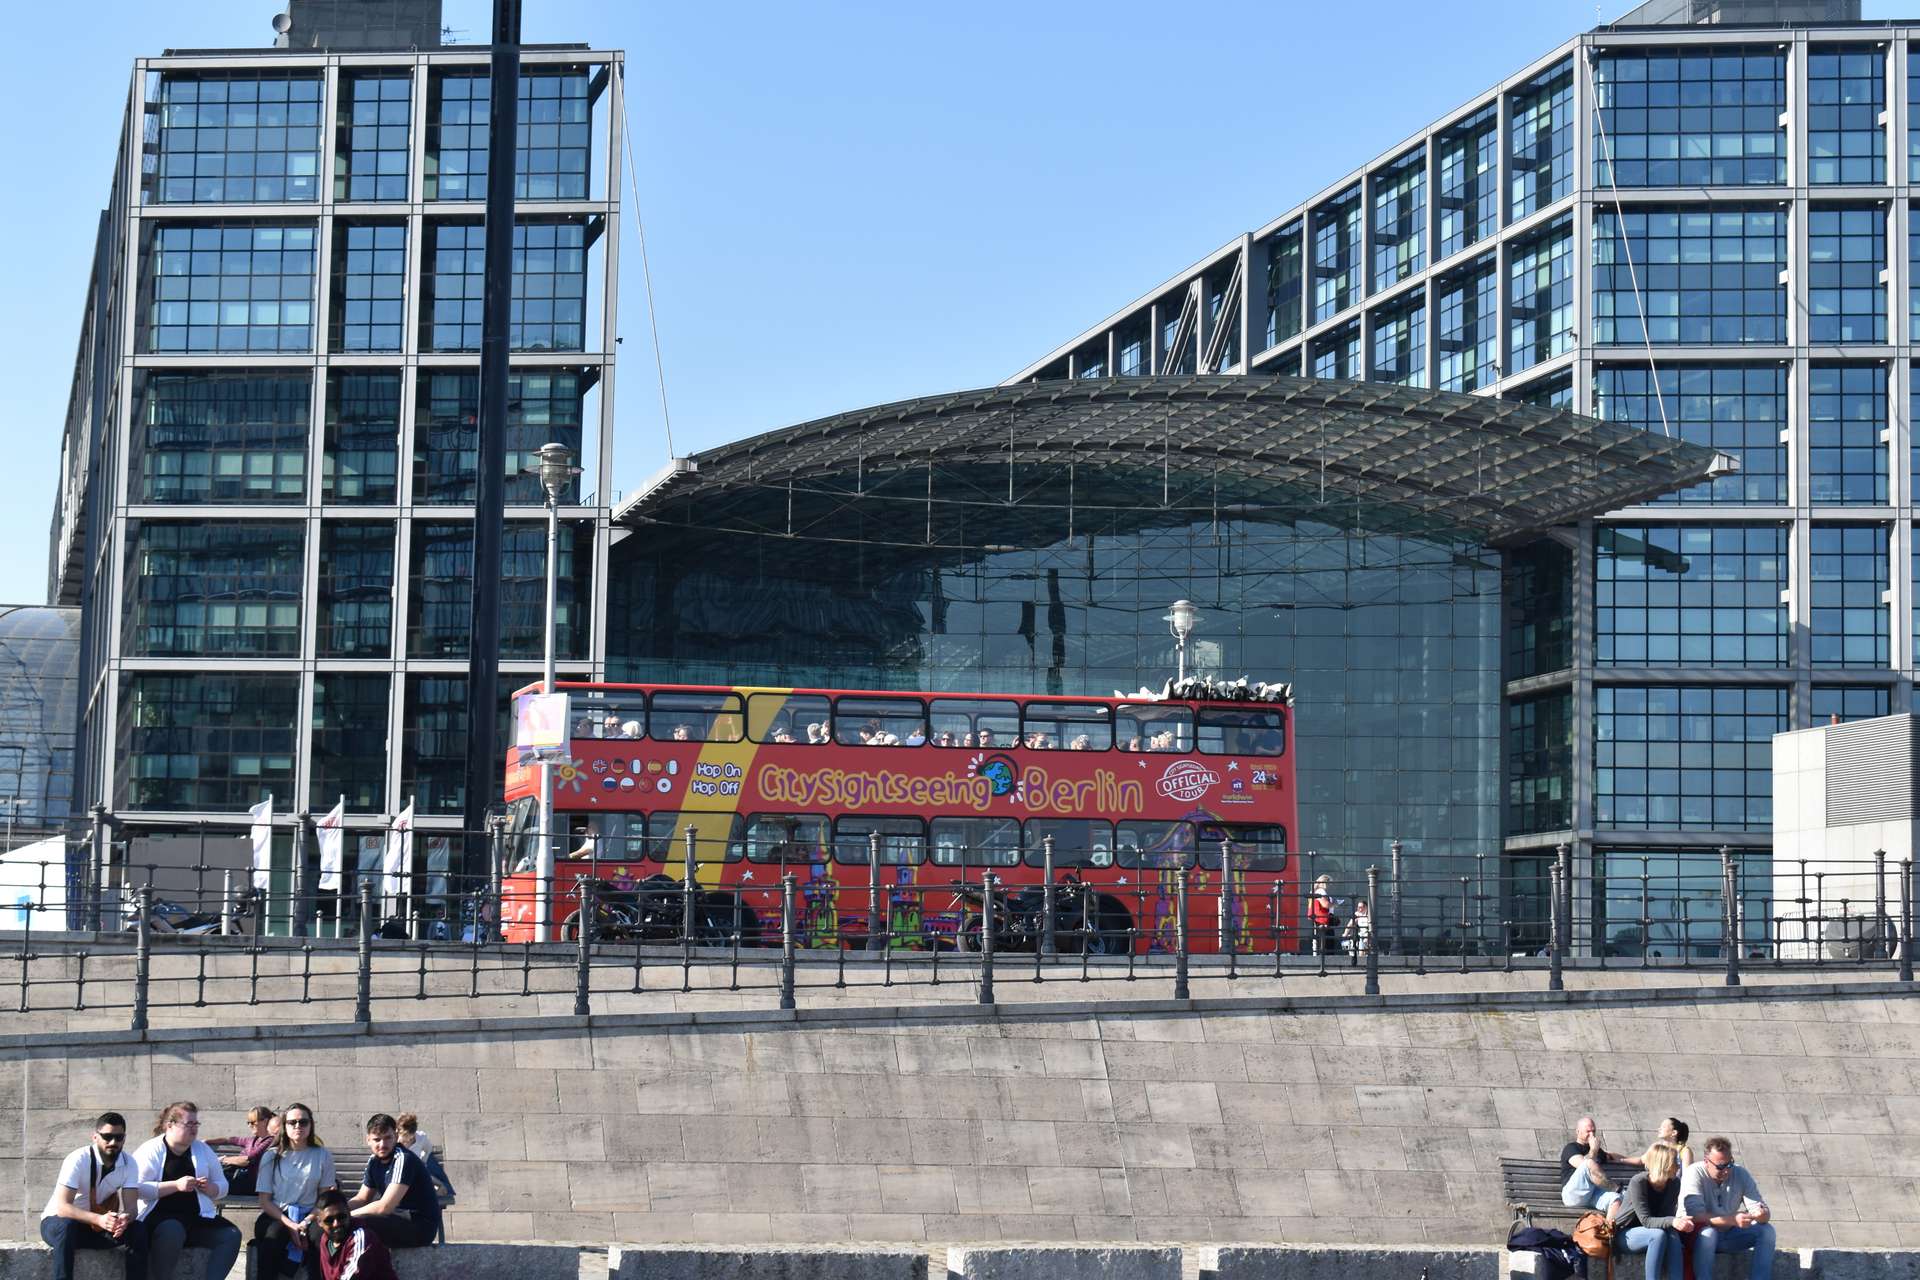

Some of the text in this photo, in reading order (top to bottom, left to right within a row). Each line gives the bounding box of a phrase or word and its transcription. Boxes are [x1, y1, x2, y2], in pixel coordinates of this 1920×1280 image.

[697, 762, 742, 778] Hop On
[1252, 770, 1266, 784] 24
[692, 780, 740, 797] Hop Off
[760, 764, 992, 810] CitySightseeing
[1024, 767, 1143, 812] Berlin
[1162, 772, 1217, 792] OFFICIAL
[1180, 786, 1204, 799] TOUR
